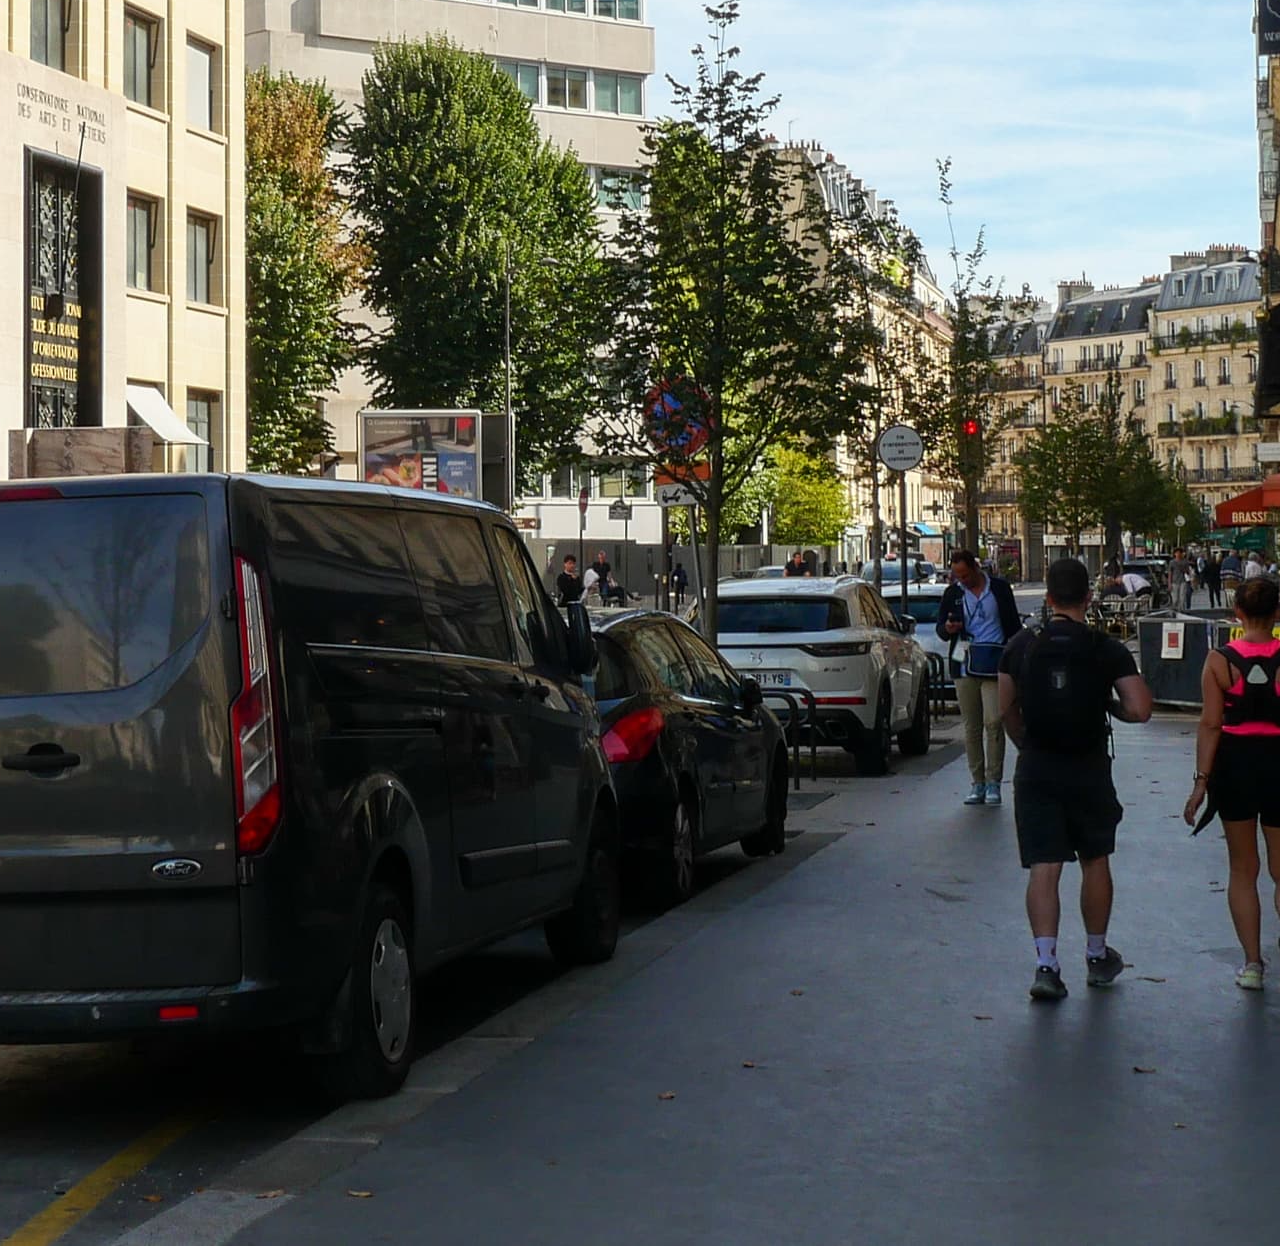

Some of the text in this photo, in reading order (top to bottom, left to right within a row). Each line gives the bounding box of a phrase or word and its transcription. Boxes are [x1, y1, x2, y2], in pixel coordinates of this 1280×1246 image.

[17, 82, 69, 113] CONSERVATOIRE
[17, 102, 32, 119] DES
[39, 110, 57, 128] ARTS
[62, 117, 71, 132] ET
